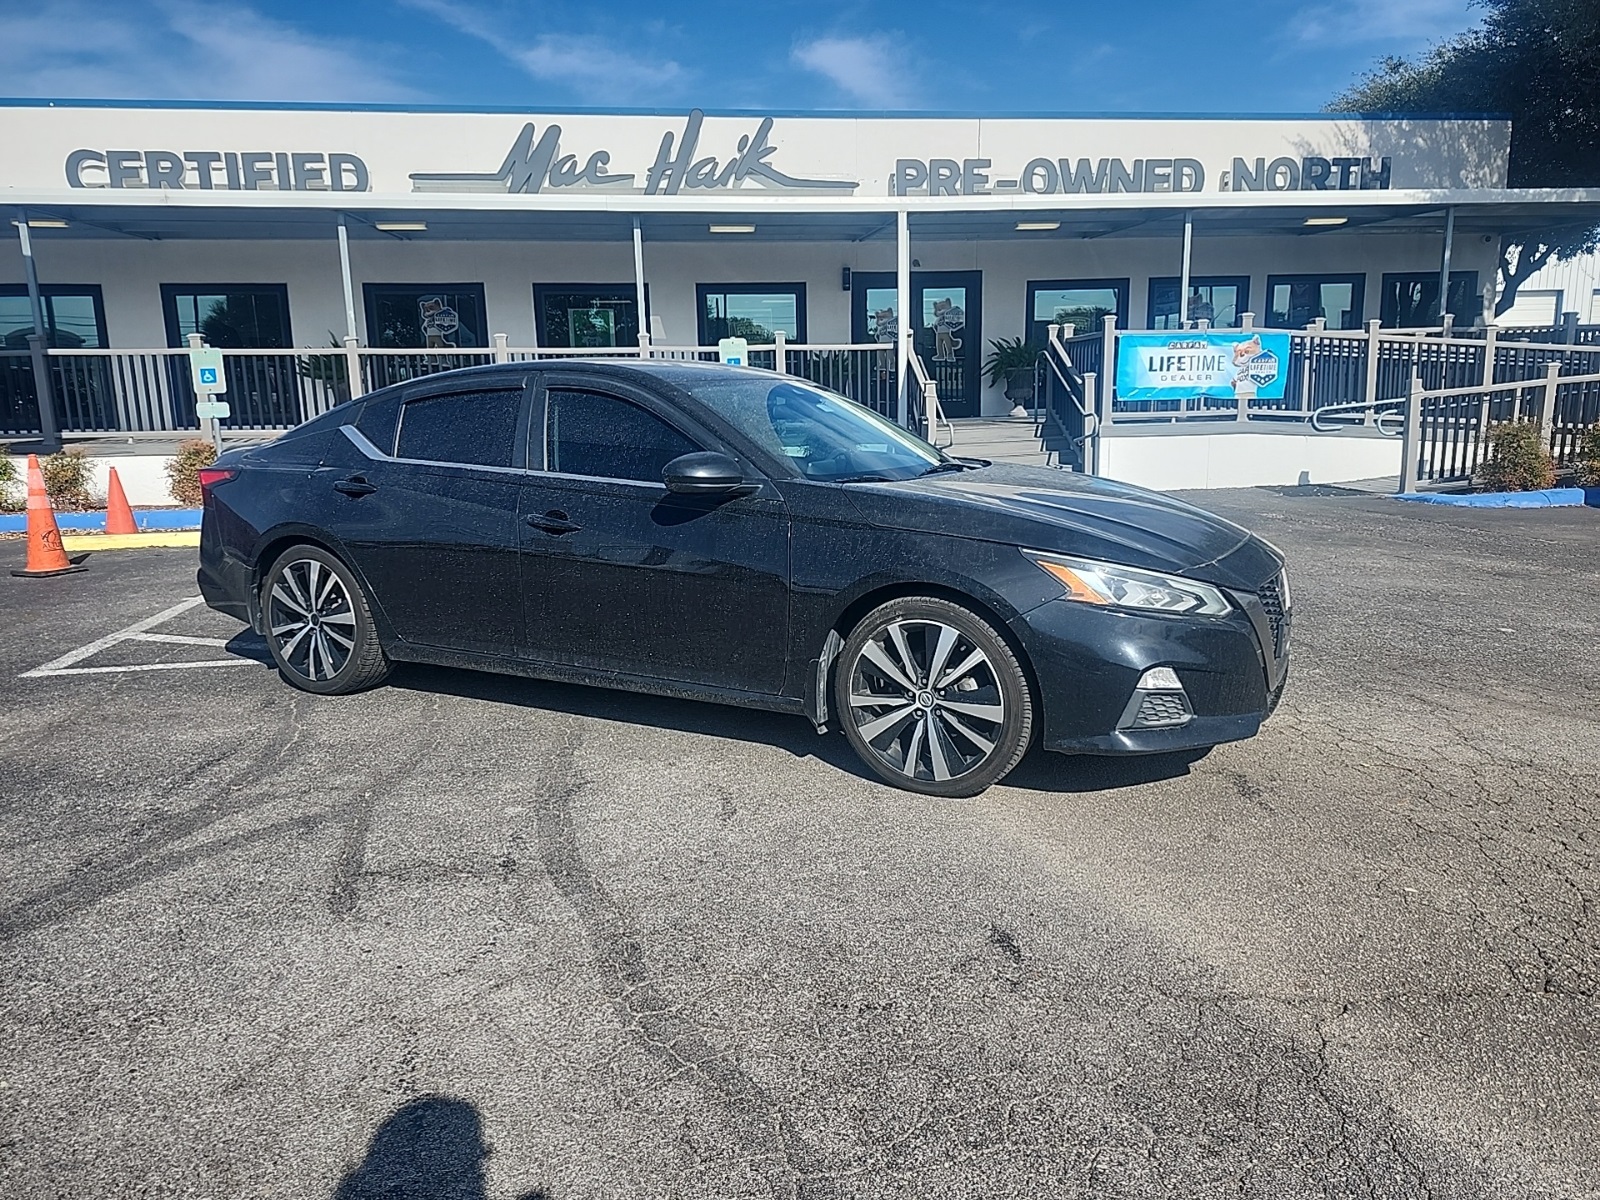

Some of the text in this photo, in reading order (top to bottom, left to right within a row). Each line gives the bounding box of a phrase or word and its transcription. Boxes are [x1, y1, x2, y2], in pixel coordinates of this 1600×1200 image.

[408, 108, 860, 195] Mac Haik
[65, 148, 370, 192] CERTIFIED
[895, 156, 1392, 196] PRE-OWNED NORTH
[1168, 341, 1208, 350] CARFAX
[1148, 355, 1226, 372] LIFETIME
[1160, 374, 1212, 382] DEALER
